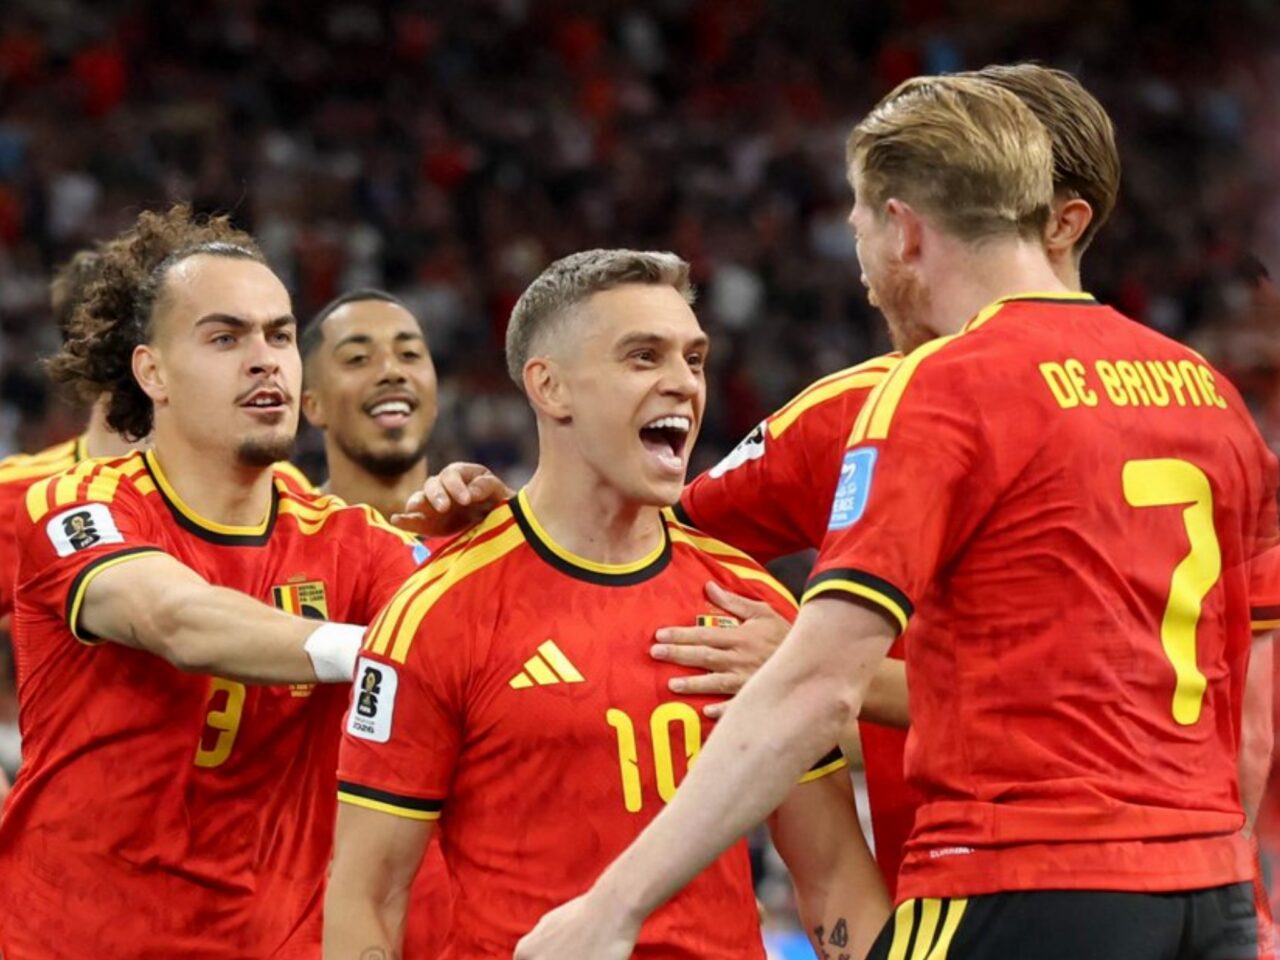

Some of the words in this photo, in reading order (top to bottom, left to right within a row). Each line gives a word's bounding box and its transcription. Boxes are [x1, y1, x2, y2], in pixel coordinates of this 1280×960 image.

[1038, 358, 1098, 409] DE
[1095, 360, 1228, 410] BRUYNE
[1122, 457, 1222, 726] 7
[194, 676, 246, 768] 3
[606, 701, 702, 813] 10
